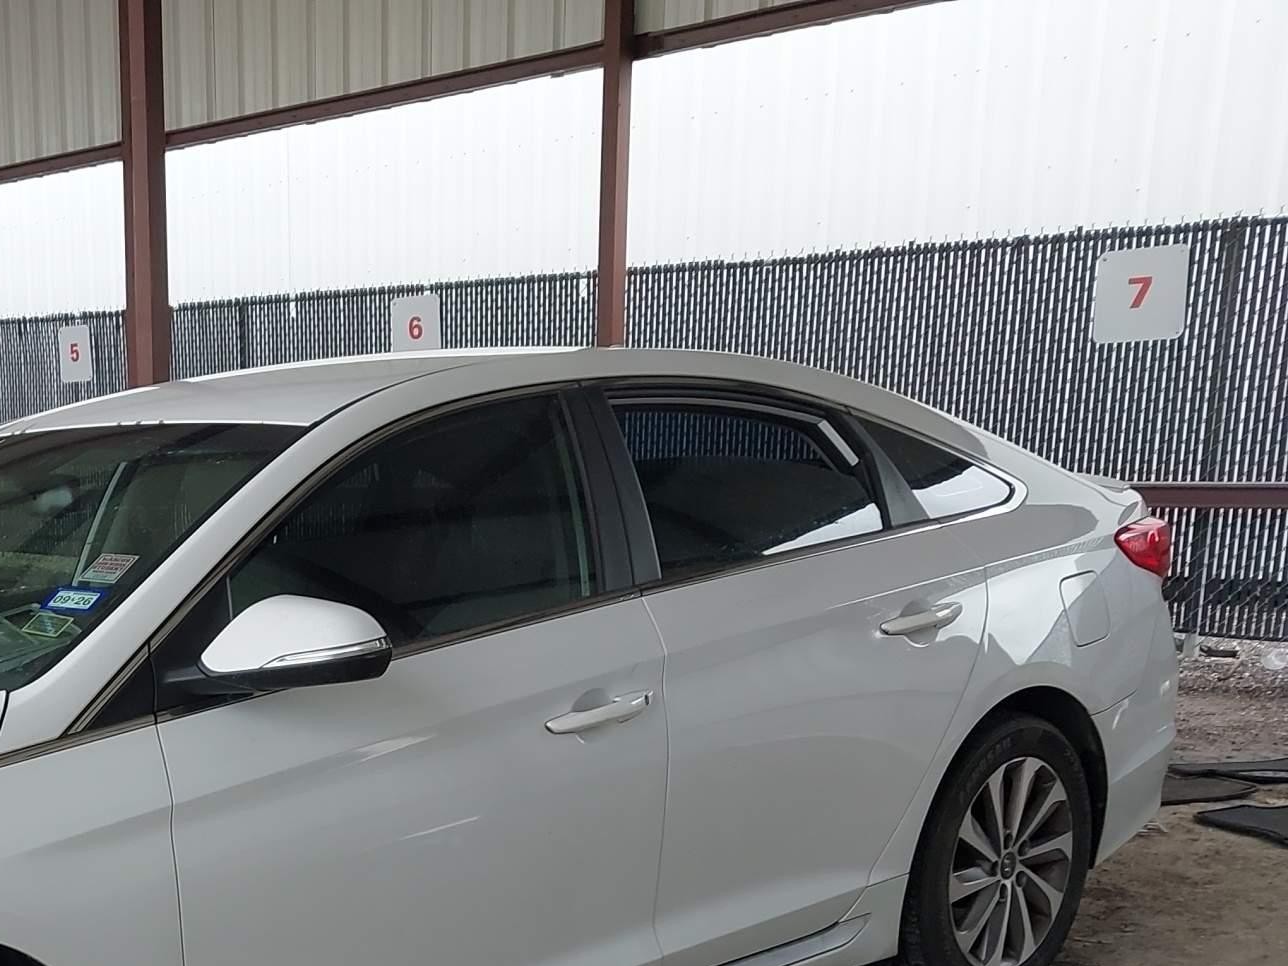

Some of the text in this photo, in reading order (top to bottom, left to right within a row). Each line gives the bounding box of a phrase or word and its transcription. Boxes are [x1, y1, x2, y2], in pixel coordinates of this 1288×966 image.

[1127, 275, 1154, 310] 7
[408, 316, 423, 340] 6
[70, 342, 81, 363] 5
